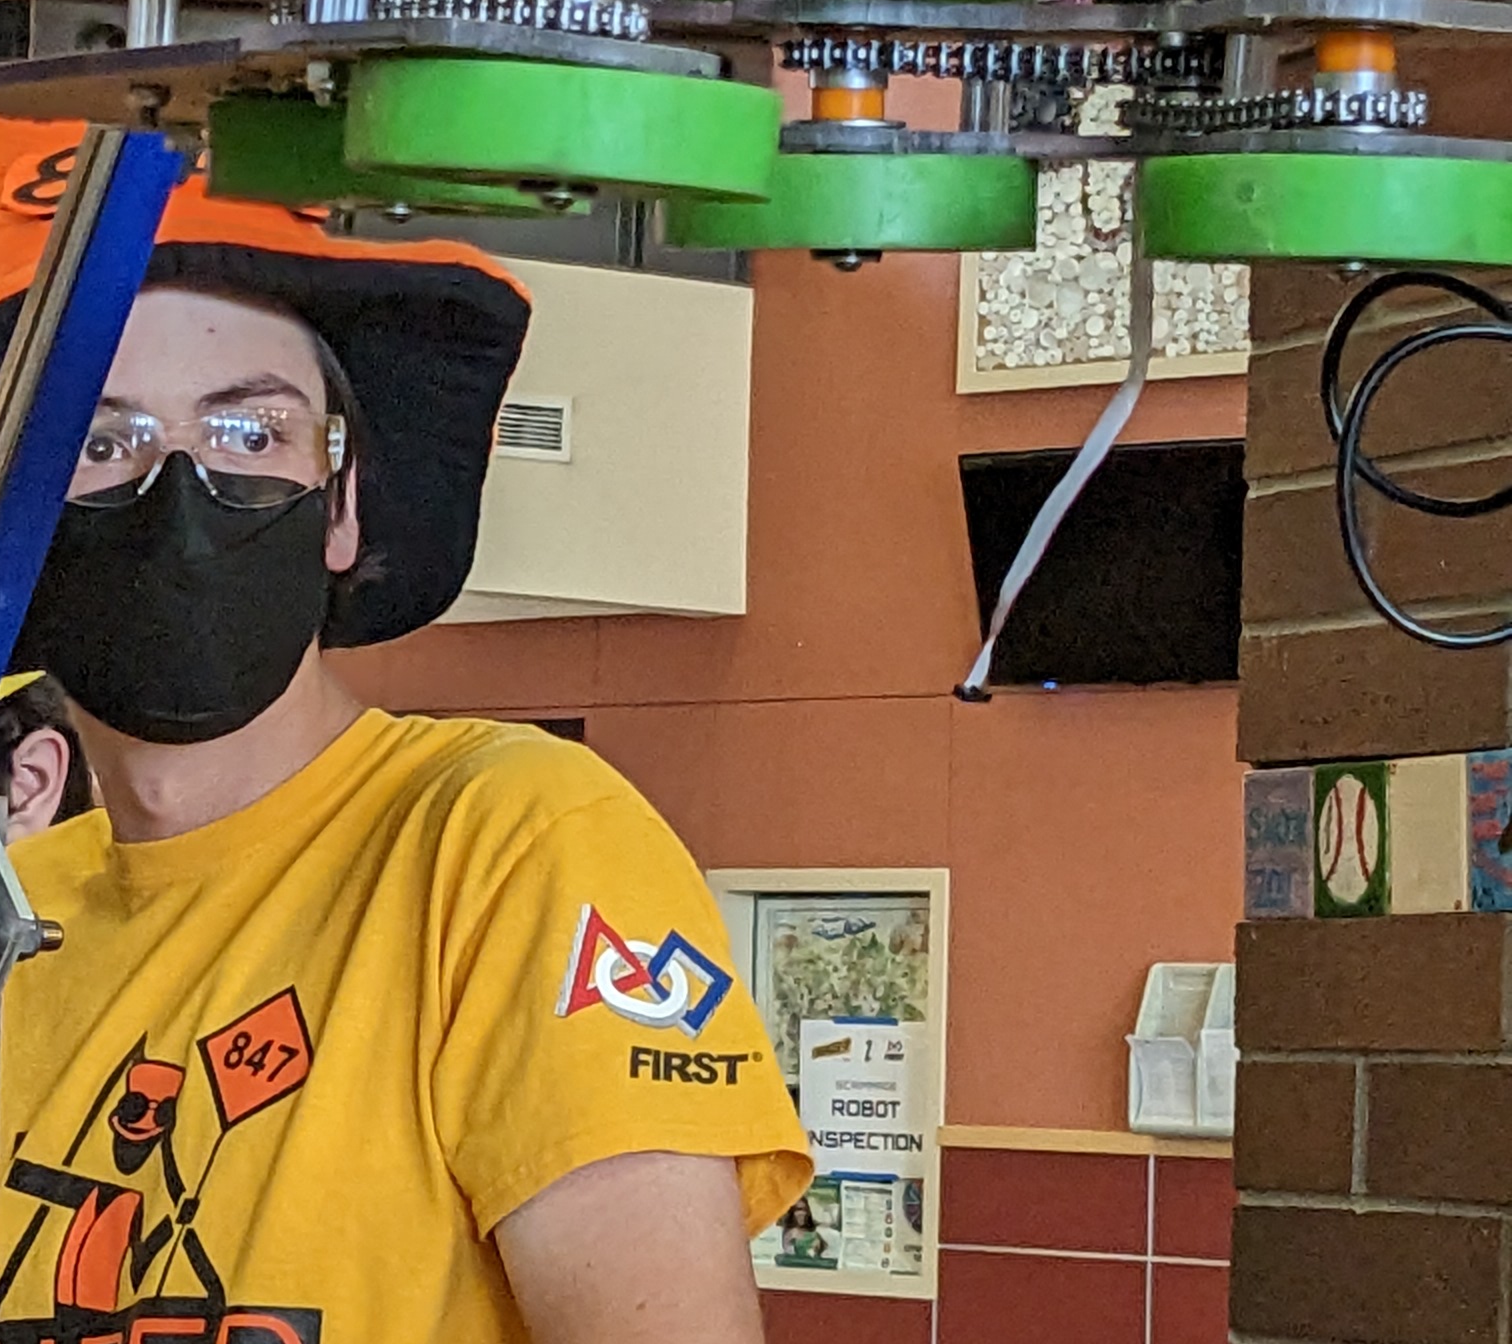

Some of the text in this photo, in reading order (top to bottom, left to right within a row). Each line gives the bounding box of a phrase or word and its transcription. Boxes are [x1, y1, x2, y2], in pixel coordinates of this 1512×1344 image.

[223, 1030, 300, 1083] 847
[630, 1045, 749, 1086] FIRST
[831, 1098, 901, 1119] ROBOT
[807, 1130, 924, 1153] NSPECTION
